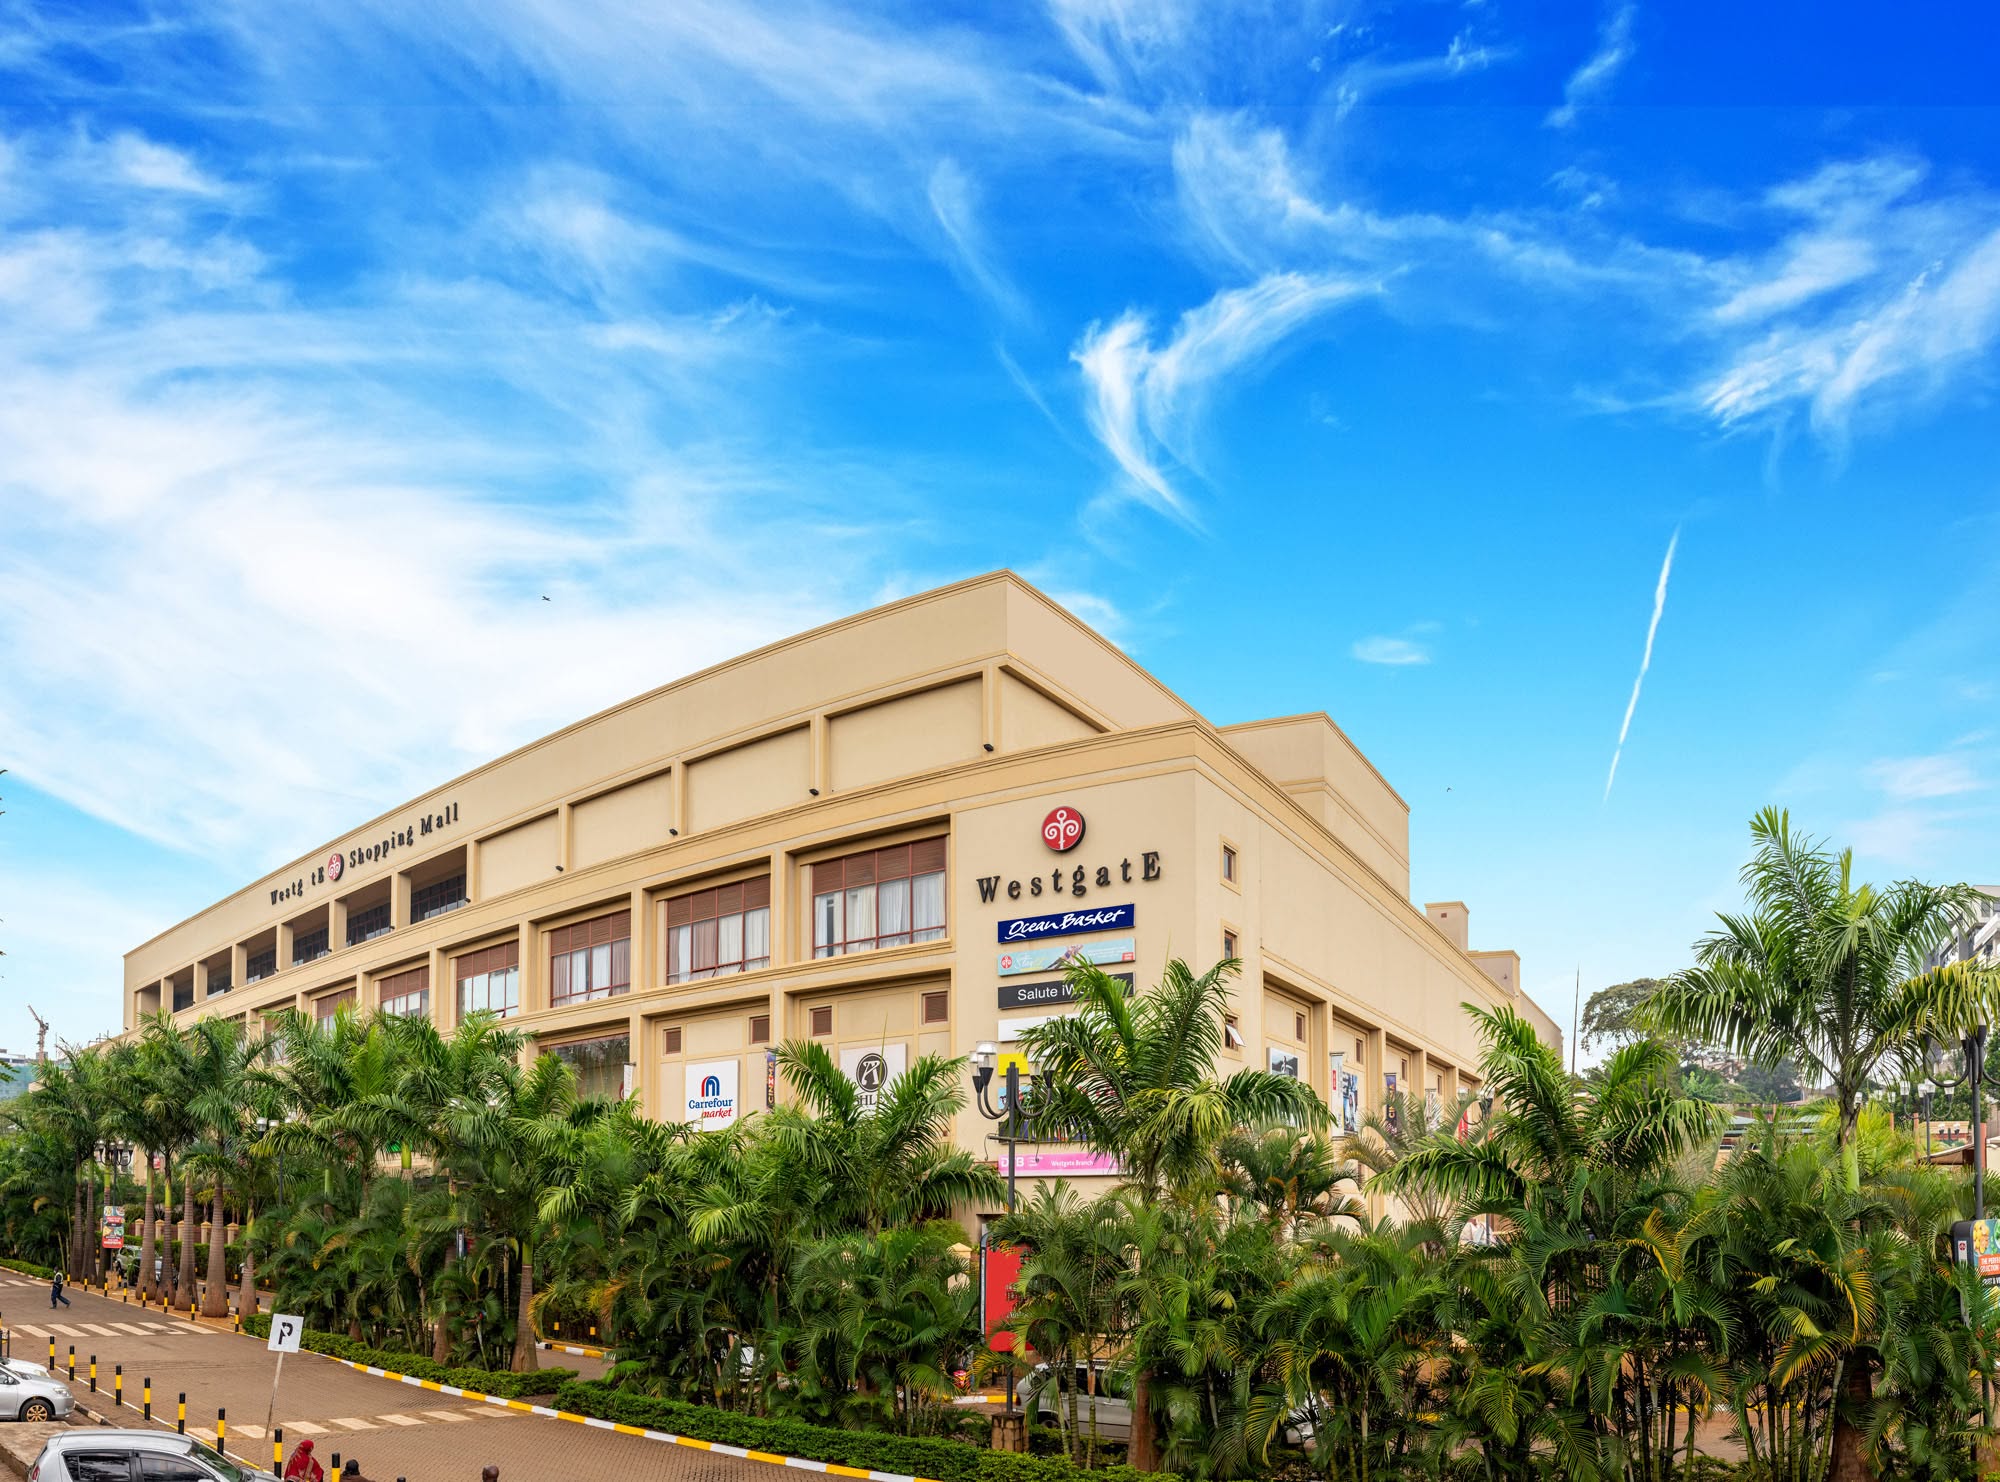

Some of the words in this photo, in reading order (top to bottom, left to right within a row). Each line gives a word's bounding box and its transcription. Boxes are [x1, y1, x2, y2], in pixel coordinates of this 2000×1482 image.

[350, 826, 414, 868] Shopping
[420, 802, 459, 836] Mall
[976, 851, 1161, 904] WestgatE
[1005, 920, 1059, 940] Ocean
[1059, 909, 1126, 930] Basket
[1017, 987, 1058, 1001] Salute
[688, 1097, 733, 1109] Carrefour
[702, 1107, 732, 1118] market
